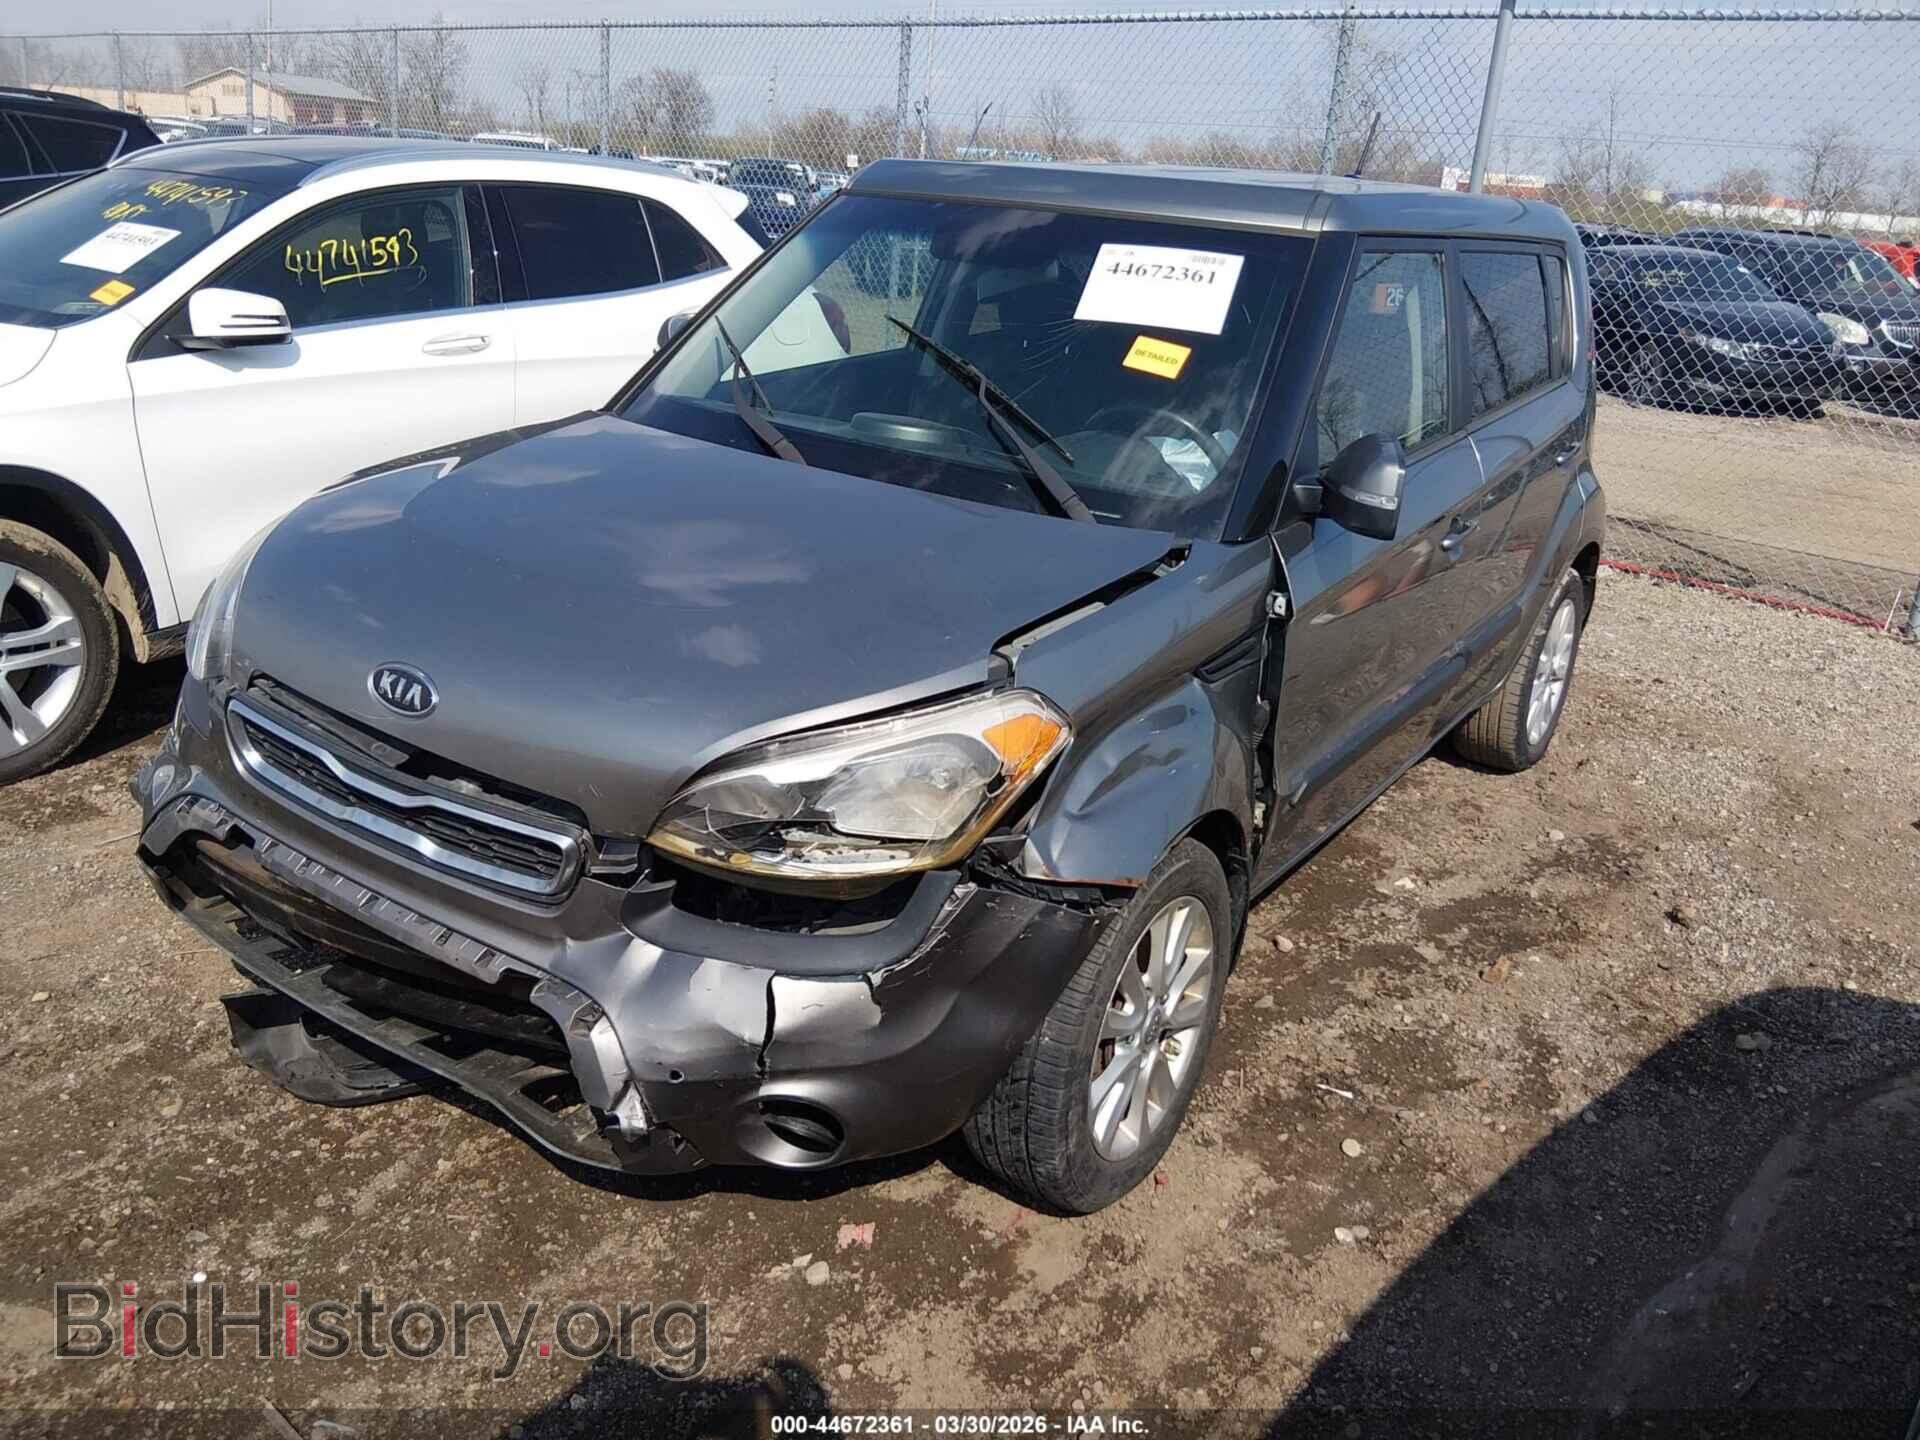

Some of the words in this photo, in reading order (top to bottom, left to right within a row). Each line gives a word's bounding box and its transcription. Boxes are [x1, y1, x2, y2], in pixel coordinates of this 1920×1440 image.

[284, 227, 419, 293] 44741593
[1106, 261, 1217, 285] 44672361
[1134, 348, 1178, 366] DETAILED
[379, 670, 423, 711] KIA
